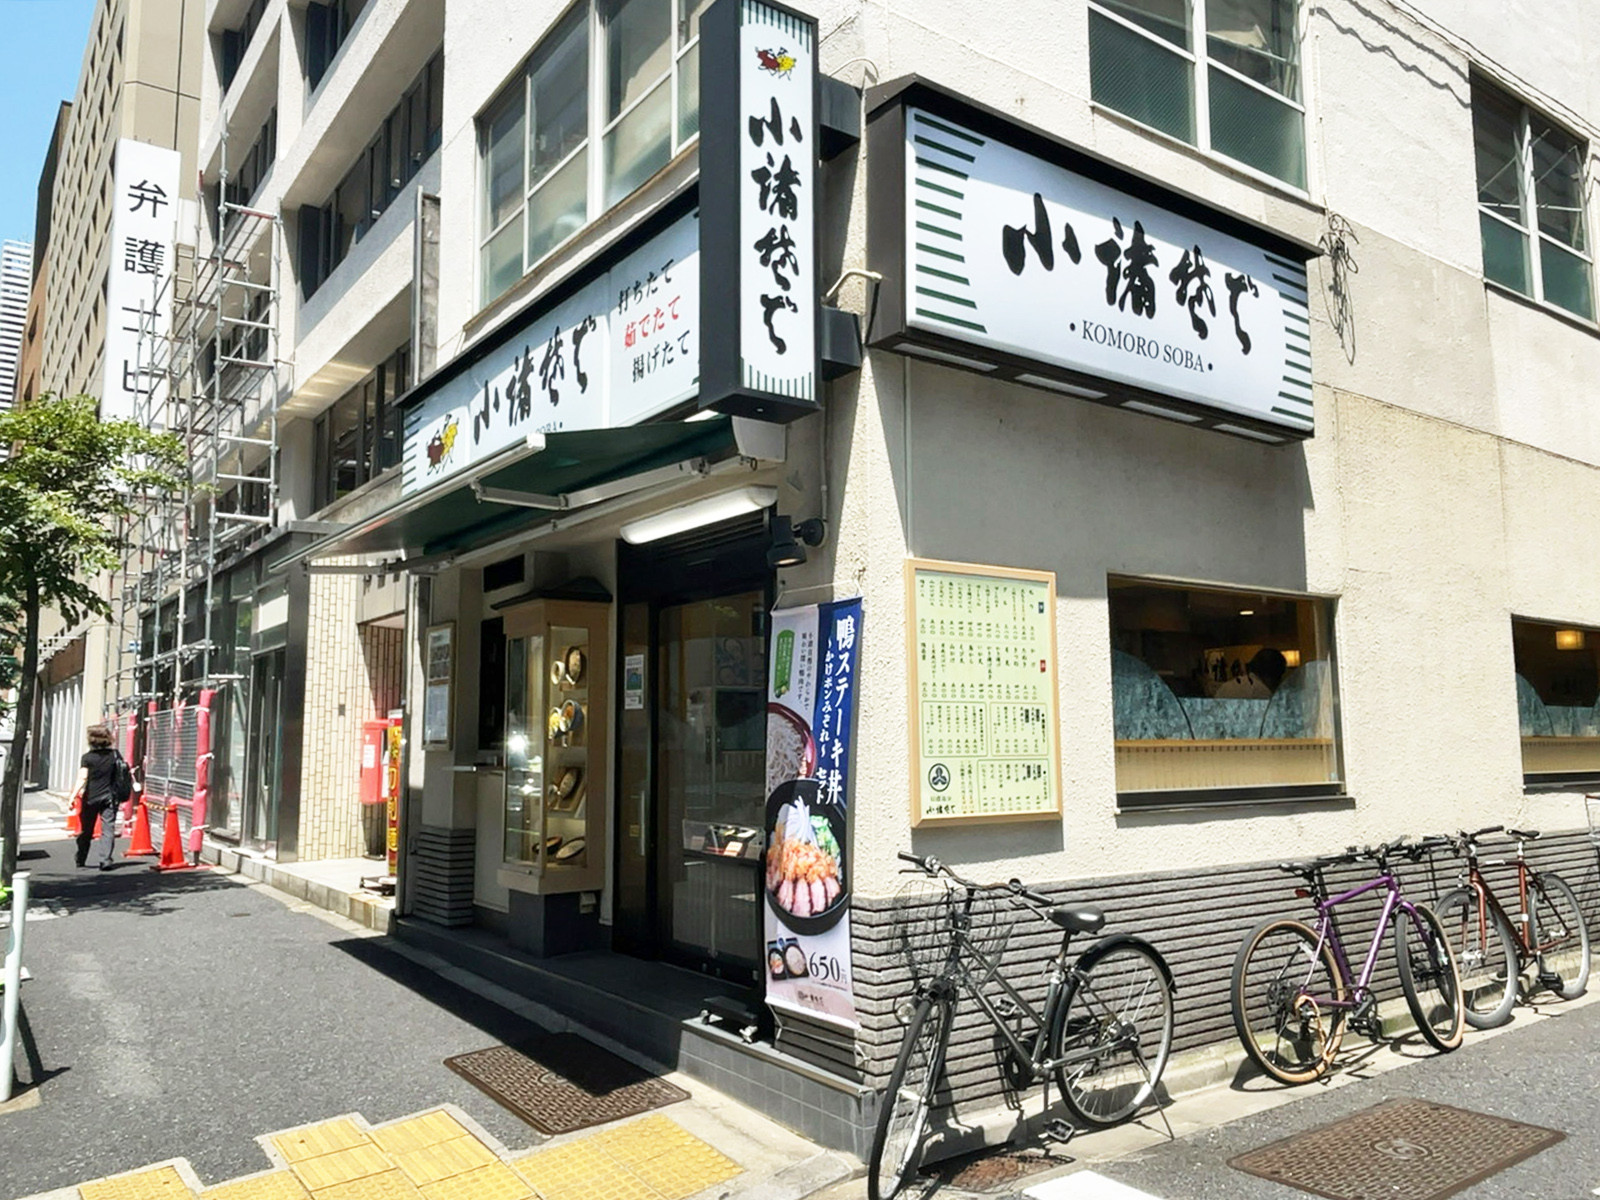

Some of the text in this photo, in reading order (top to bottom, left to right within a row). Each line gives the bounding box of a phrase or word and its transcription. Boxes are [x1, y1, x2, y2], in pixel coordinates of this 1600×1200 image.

[618, 258, 674, 315] 打ちたて
[624, 295, 681, 351] 茹でたて
[1082, 320, 1205, 373] KOMORO SOBA
[632, 329, 690, 383] 揚げたて
[826, 614, 855, 805] 鴨ステーキ丼
